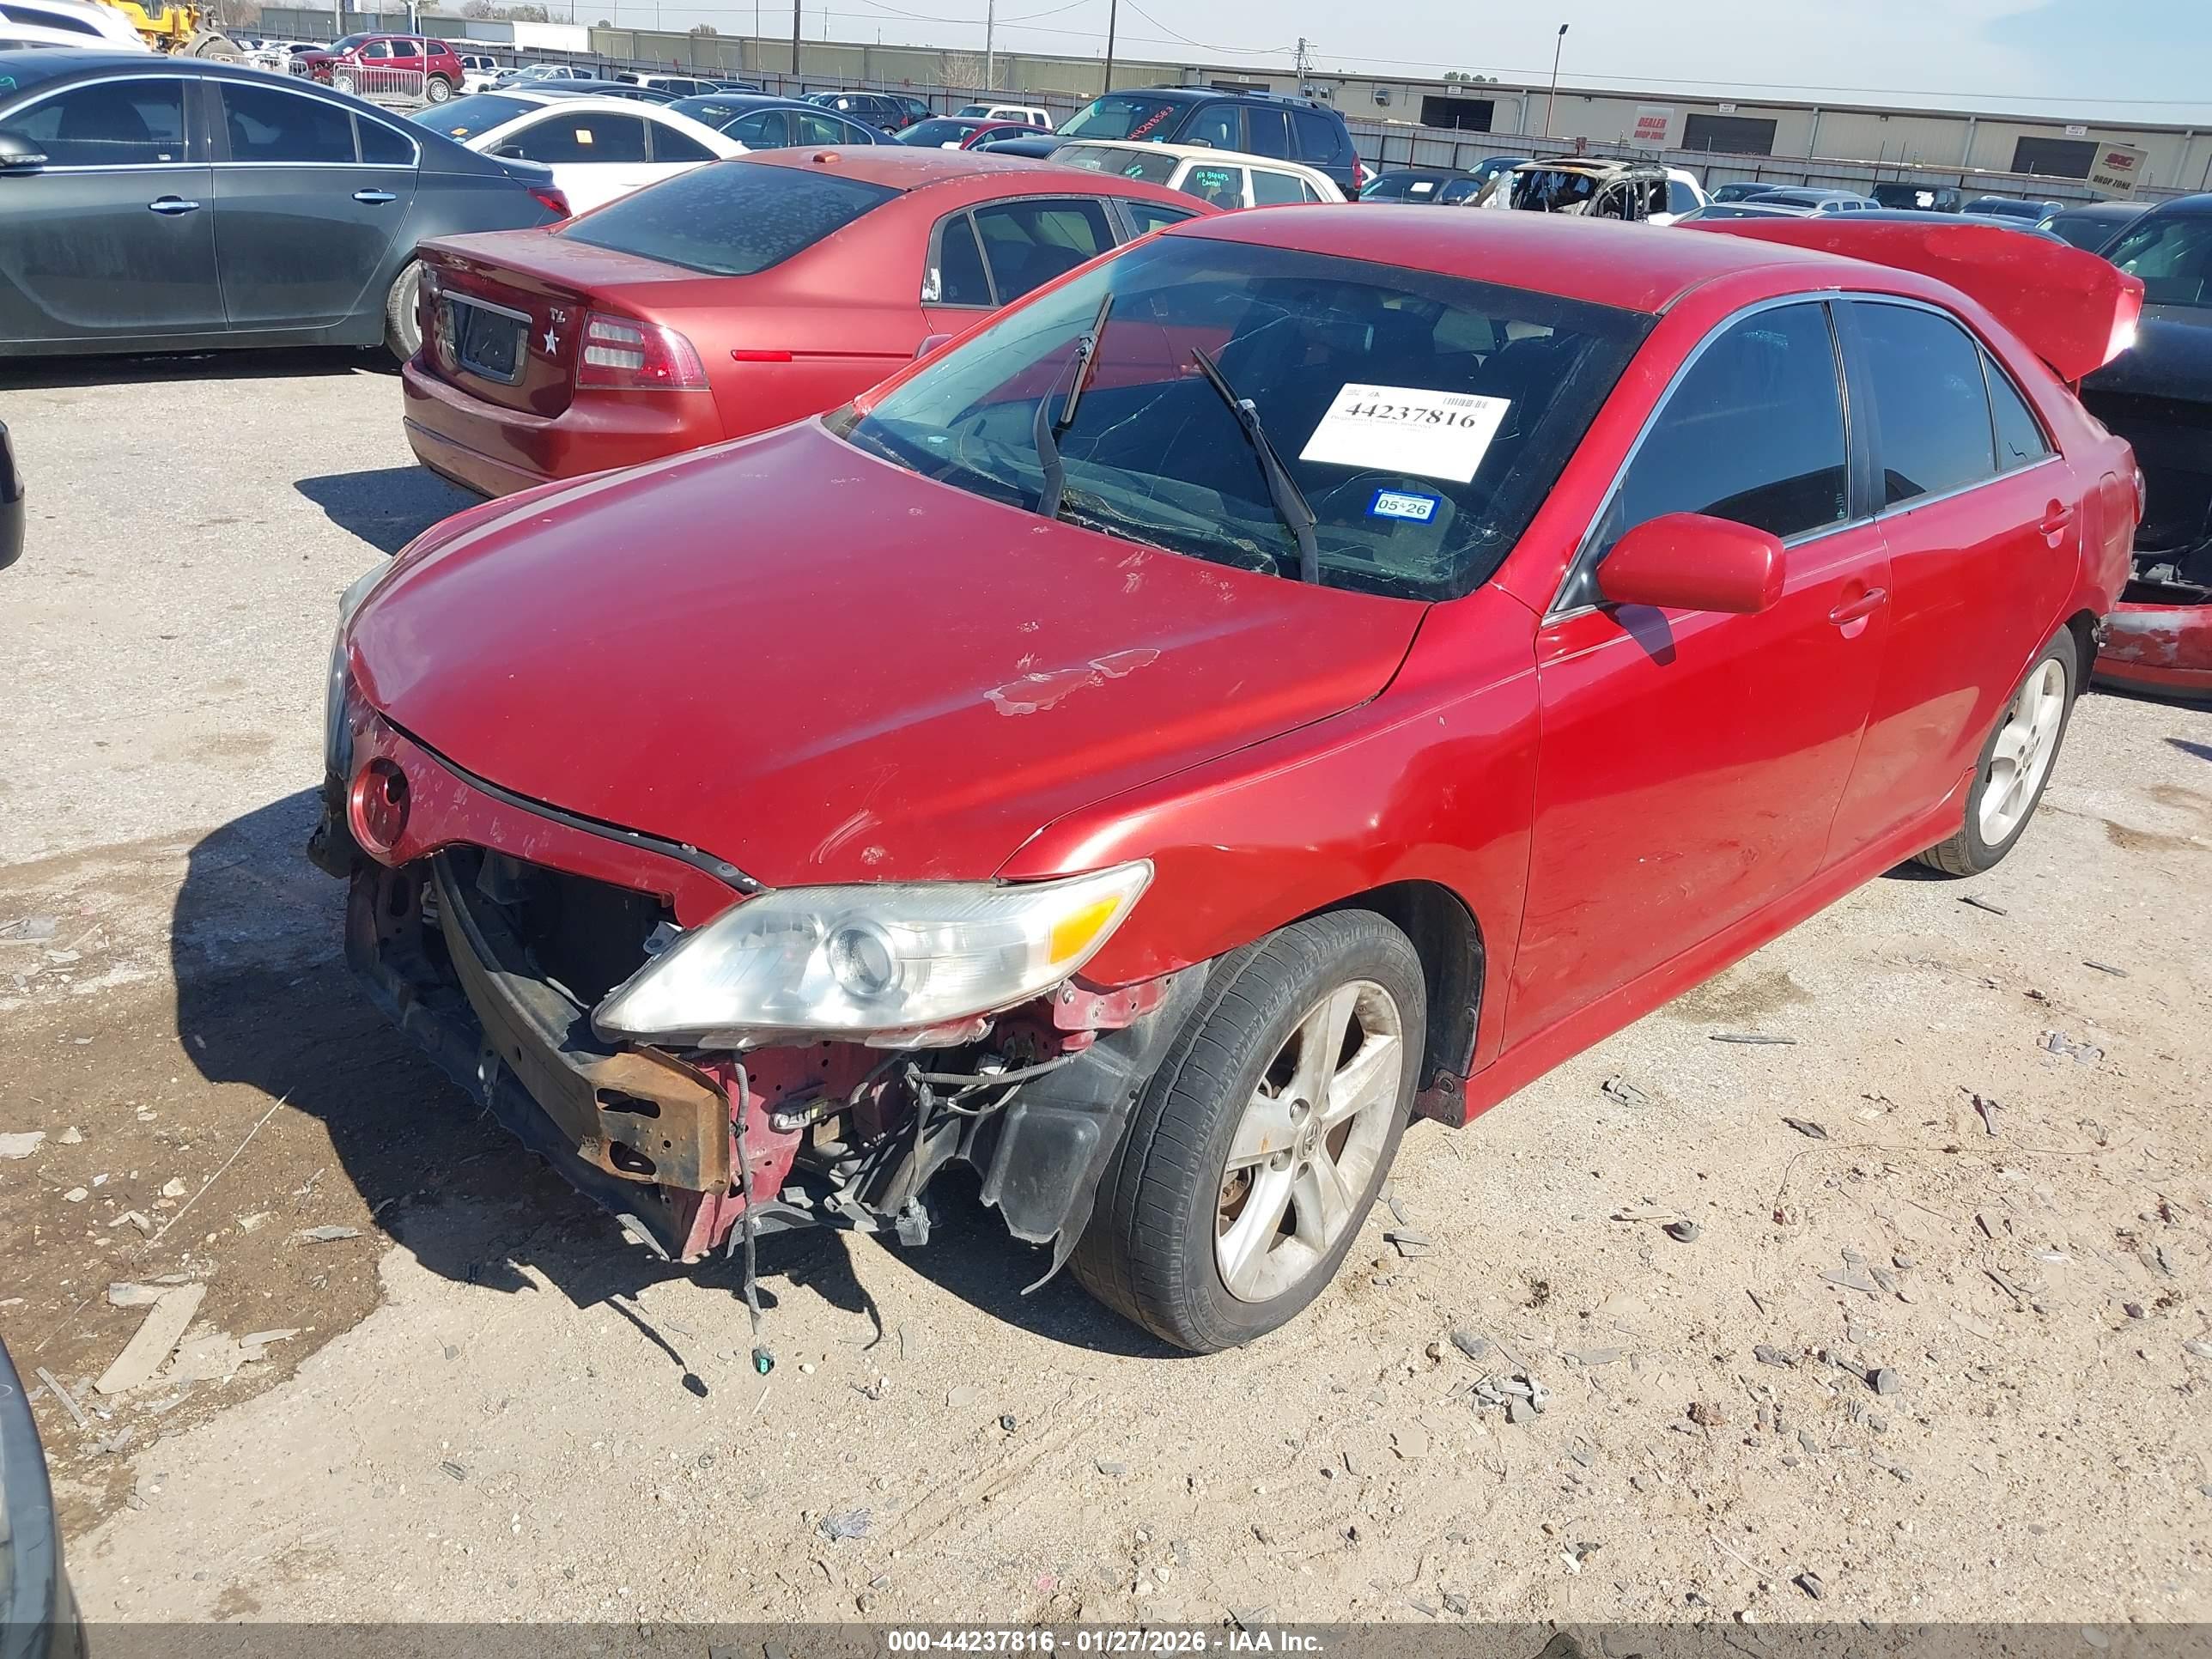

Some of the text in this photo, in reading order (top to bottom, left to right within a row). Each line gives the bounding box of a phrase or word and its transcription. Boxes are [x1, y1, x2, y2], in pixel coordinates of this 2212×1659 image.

[1638, 117, 1667, 128] DEALER
[1196, 171, 1205, 179] NO
[2093, 174, 2132, 191] DROP ZONE
[550, 307, 566, 323] TL
[1345, 402, 1477, 428] 44237816
